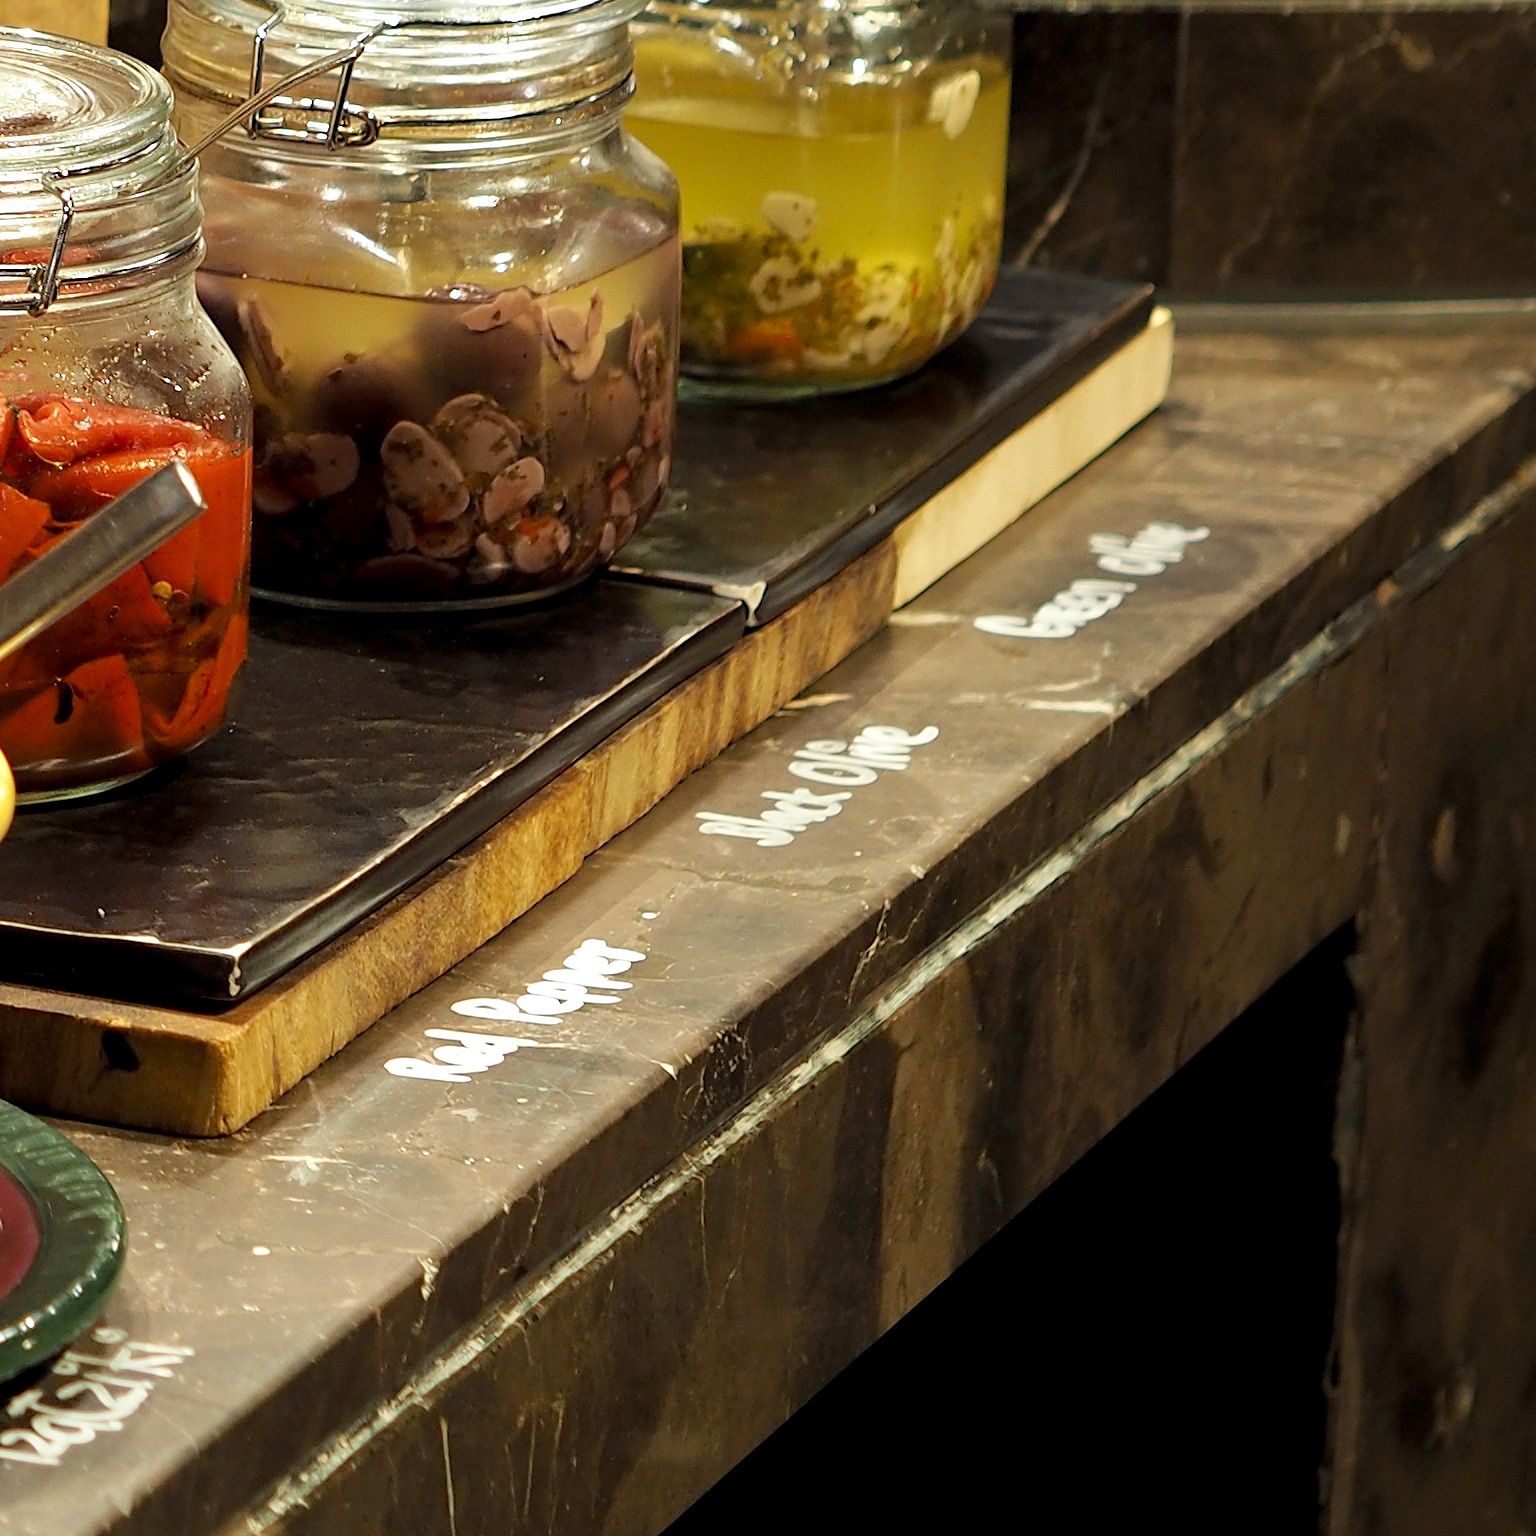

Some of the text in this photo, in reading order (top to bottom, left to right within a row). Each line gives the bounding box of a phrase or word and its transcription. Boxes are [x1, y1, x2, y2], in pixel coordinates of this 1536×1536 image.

[972, 577, 1138, 639] Green
[694, 725, 940, 847] Black Olive
[383, 938, 647, 1083] Red Pepper
